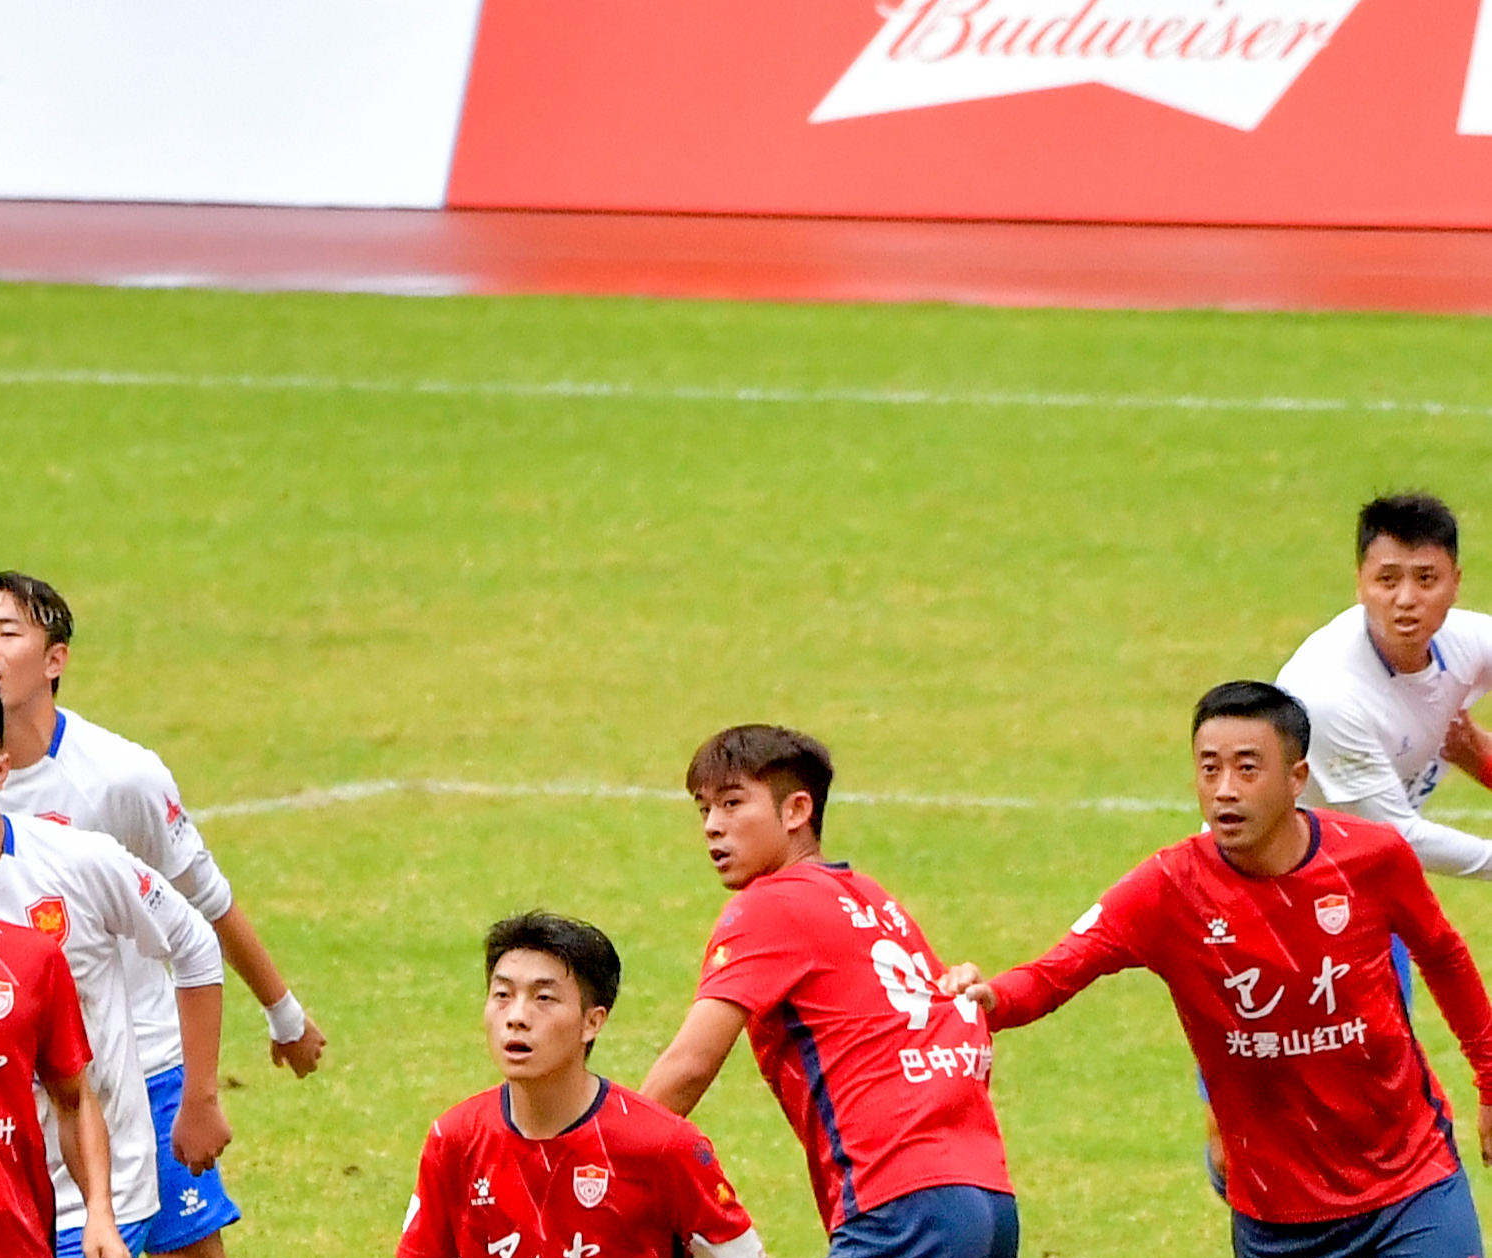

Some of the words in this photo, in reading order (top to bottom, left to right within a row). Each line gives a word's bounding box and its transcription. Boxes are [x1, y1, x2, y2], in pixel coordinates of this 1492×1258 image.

[875, 0, 1332, 63] Budweiser
[1225, 1016, 1368, 1059] 光雾山红叶
